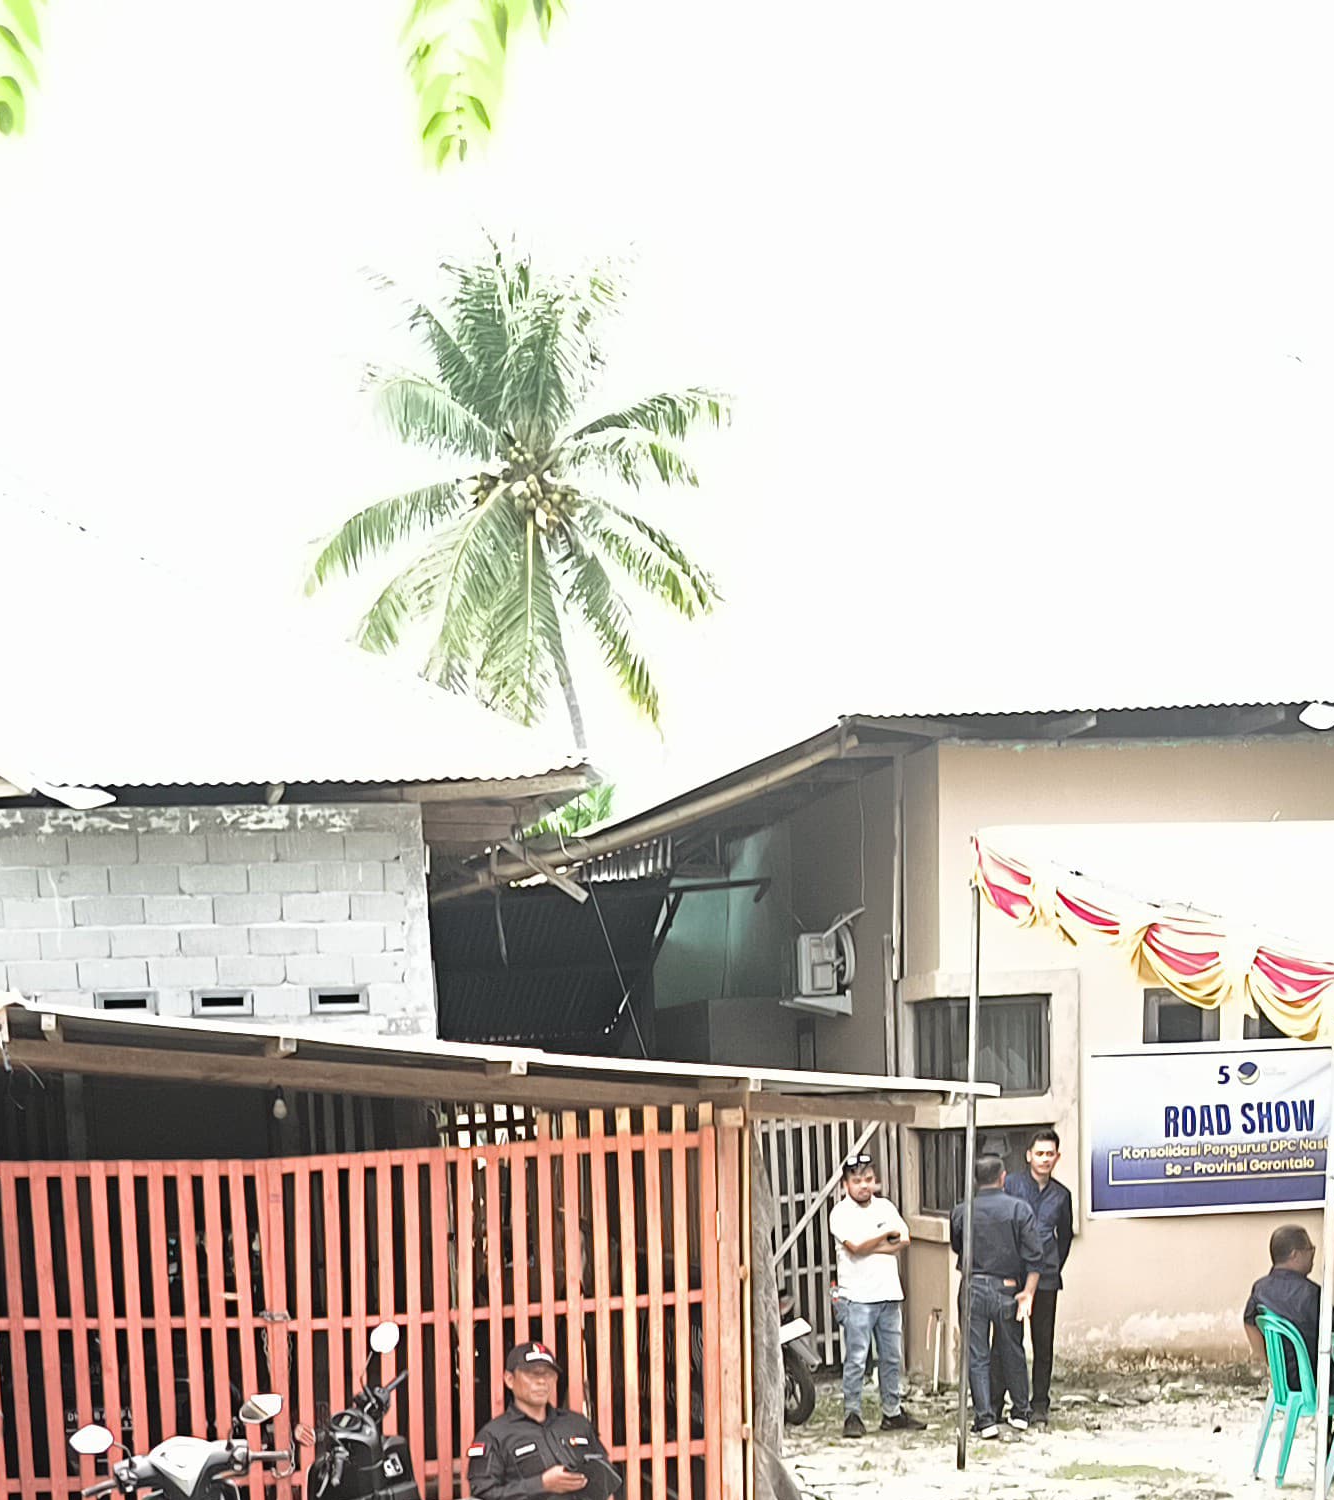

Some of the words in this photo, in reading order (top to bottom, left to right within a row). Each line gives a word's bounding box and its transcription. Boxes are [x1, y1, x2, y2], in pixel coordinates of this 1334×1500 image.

[1217, 1065, 1230, 1085] 5
[1164, 1103, 1232, 1138] ROAD
[1240, 1099, 1315, 1134] SHOW
[1122, 1141, 1202, 1160] Konsolidasi
[1203, 1141, 1268, 1158] Pengurus
[1269, 1139, 1296, 1153] DPC
[1193, 1159, 1248, 1174] Provinsi
[1250, 1156, 1315, 1172] Gorontalo
